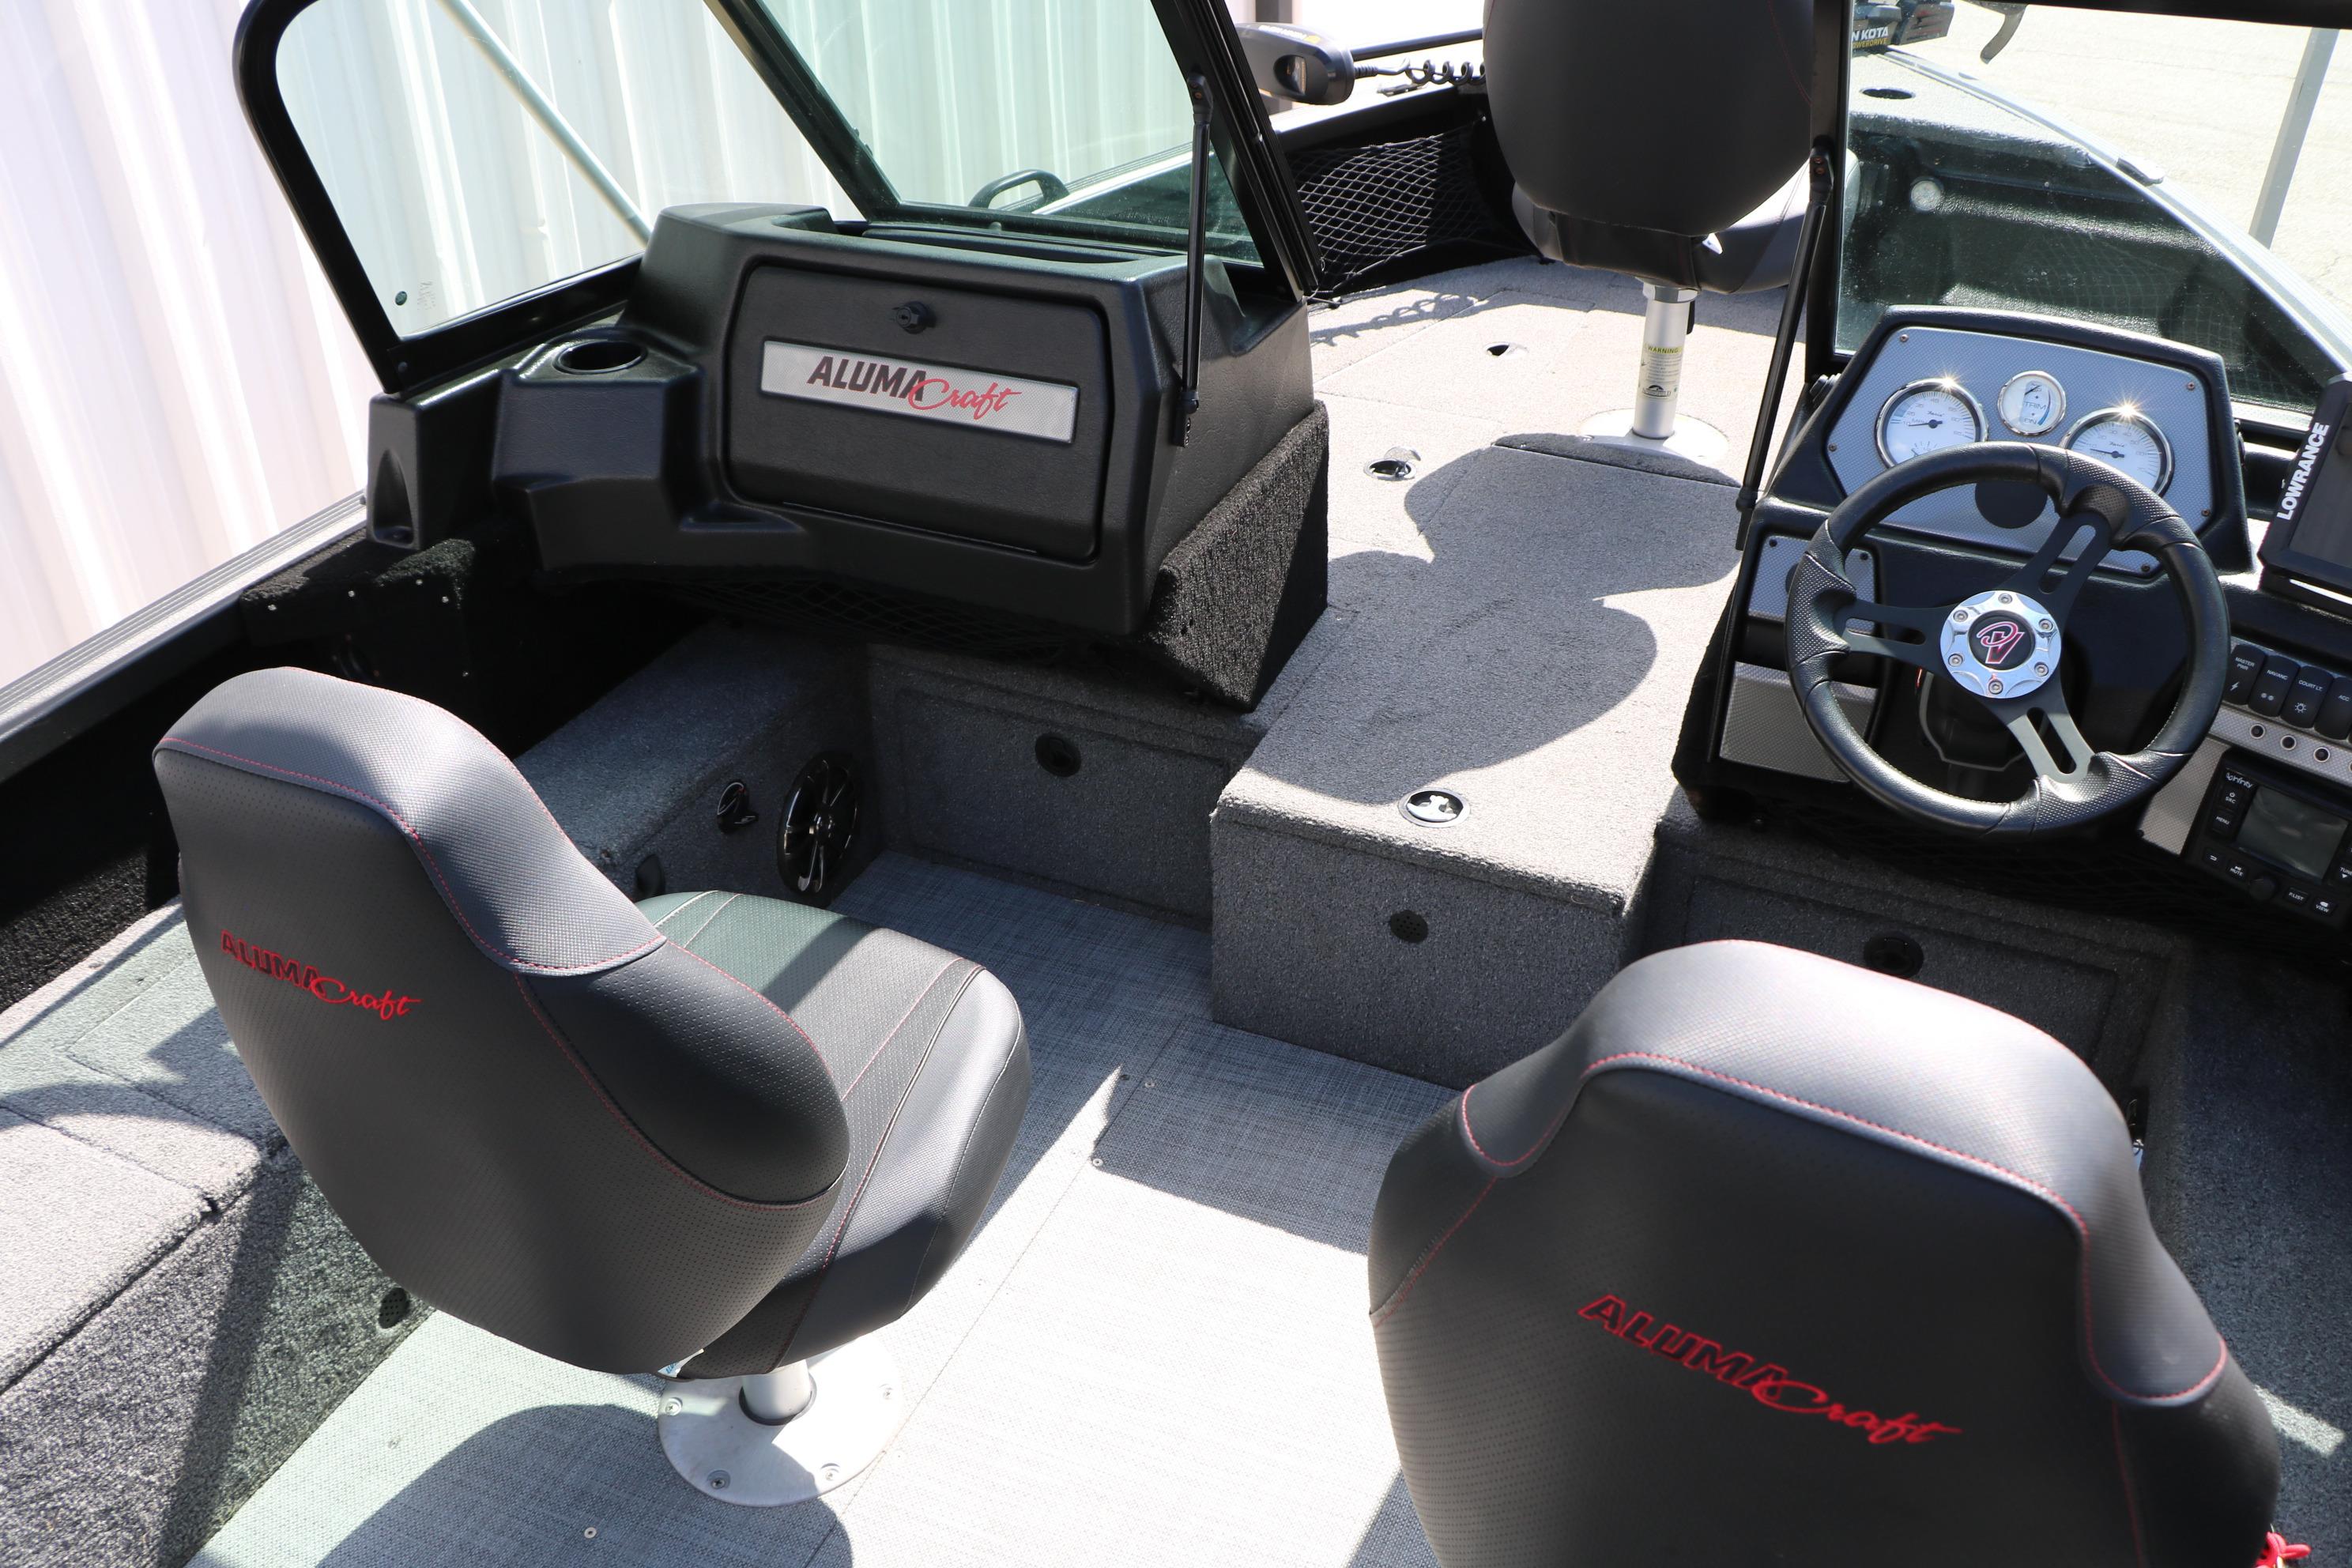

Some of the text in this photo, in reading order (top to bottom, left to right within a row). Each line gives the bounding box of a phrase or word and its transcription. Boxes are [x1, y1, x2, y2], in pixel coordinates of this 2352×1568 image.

[1861, 26, 1889, 39] KOTA
[2025, 401, 2047, 410] TRIM
[2276, 422, 2331, 521] LOWRANCE
[2235, 657, 2255, 667] MASTER
[2298, 680, 2316, 689] COURT
[2215, 816, 2230, 825] MENU
[2230, 868, 2244, 876] MUTE
[2316, 904, 2330, 913] VIEW
